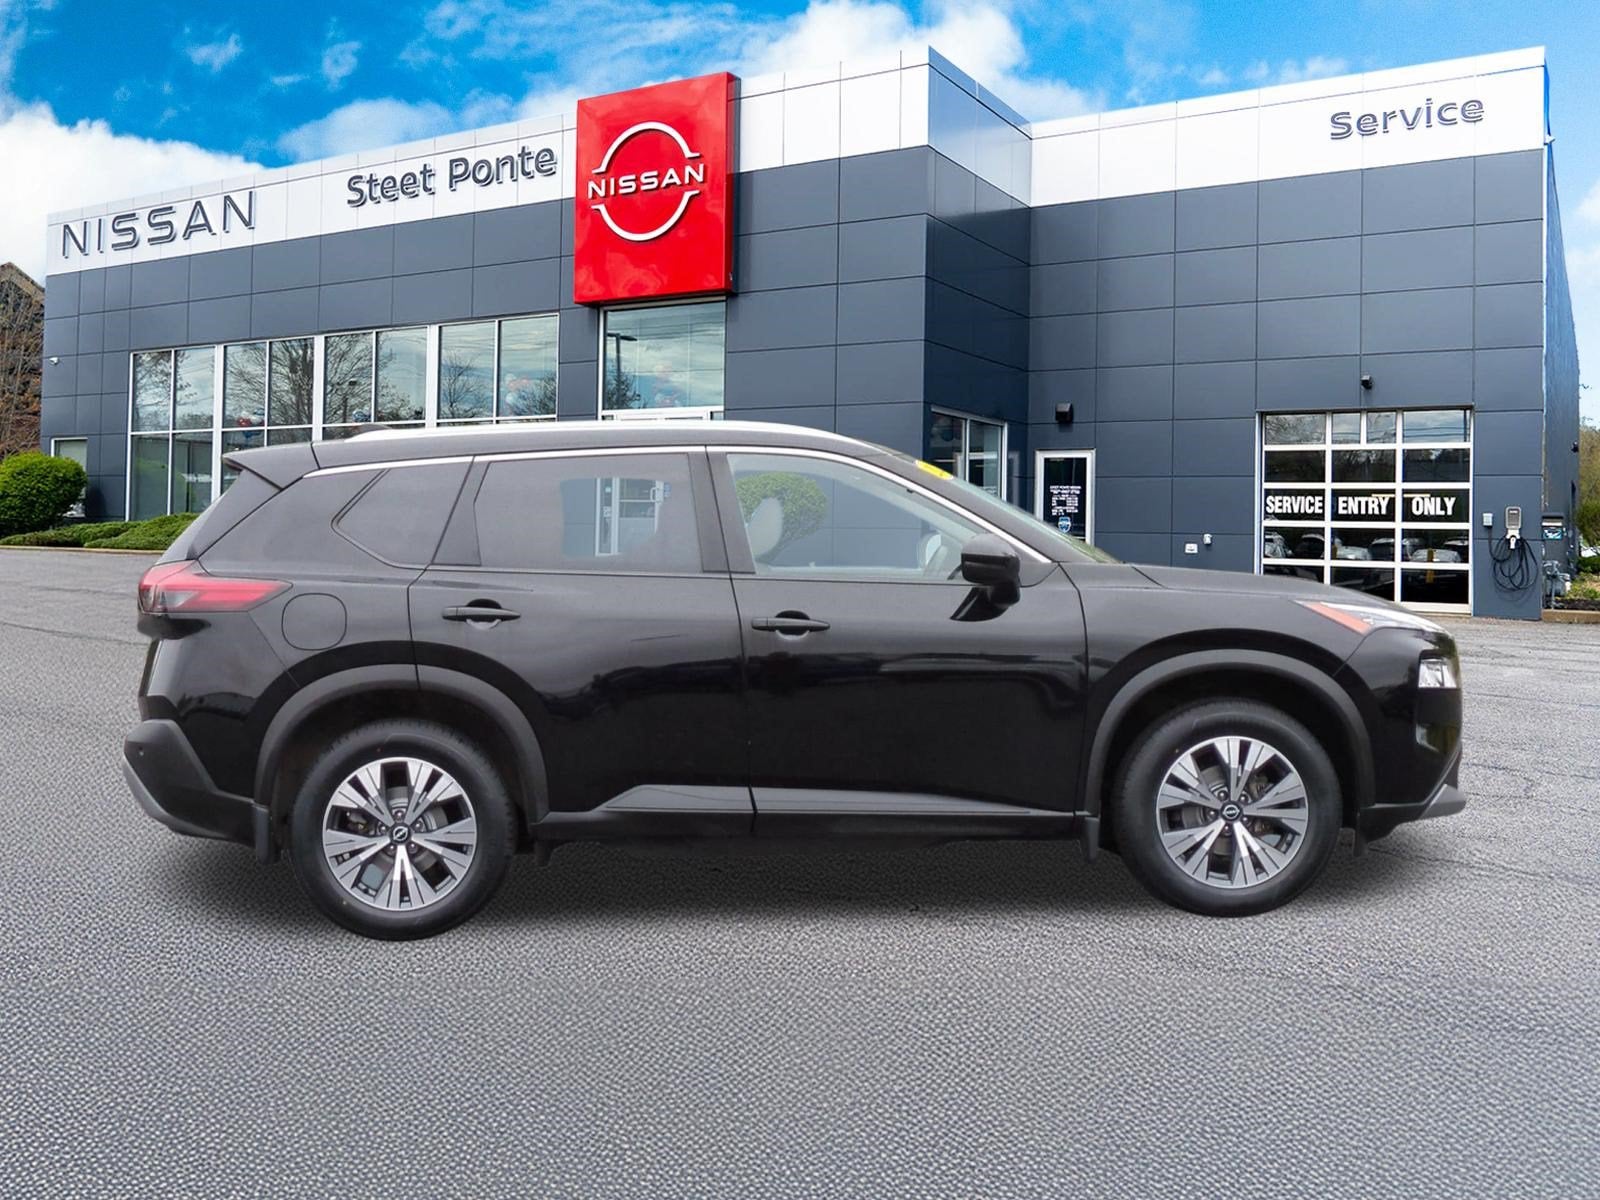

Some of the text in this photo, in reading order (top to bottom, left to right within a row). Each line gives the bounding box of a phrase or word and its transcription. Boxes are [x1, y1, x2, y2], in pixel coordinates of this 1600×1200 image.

[1330, 98, 1484, 140] Service
[347, 146, 557, 207] Steet Ponte
[587, 163, 705, 199] NISSAN
[62, 191, 255, 259] NISSAN
[1265, 495, 1456, 516] SERVICE ENTRY ONLY
